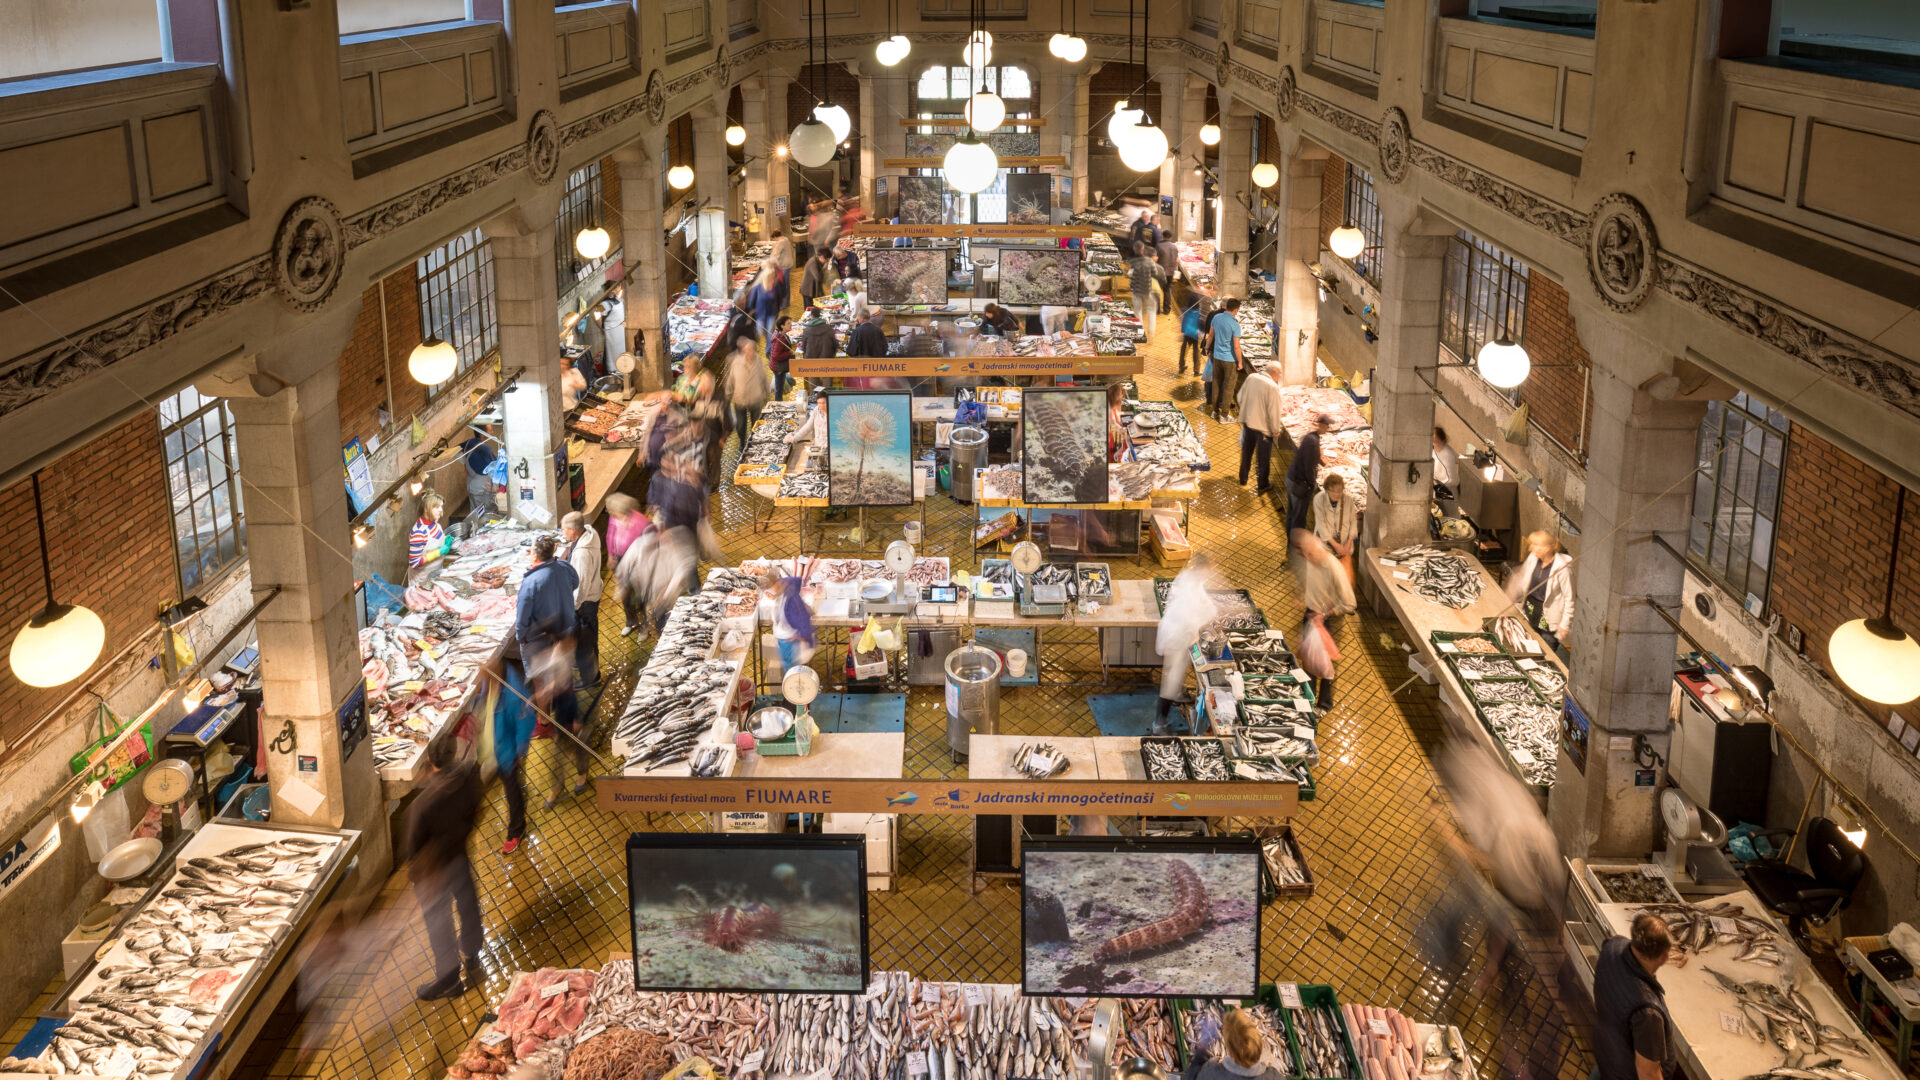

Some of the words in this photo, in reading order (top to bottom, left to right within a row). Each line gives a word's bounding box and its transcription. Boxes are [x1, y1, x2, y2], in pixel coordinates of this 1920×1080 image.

[862, 363, 907, 372] FIUMARE
[981, 362, 1018, 370] Jadranski
[614, 792, 668, 802] Kvarnerski
[670, 793, 707, 805] festival
[710, 795, 736, 803] mora
[745, 789, 832, 804] FIUMARE
[974, 791, 1045, 803] Jadranski
[1047, 791, 1155, 806] mnogočetinaši
[0, 839, 28, 874] DA
